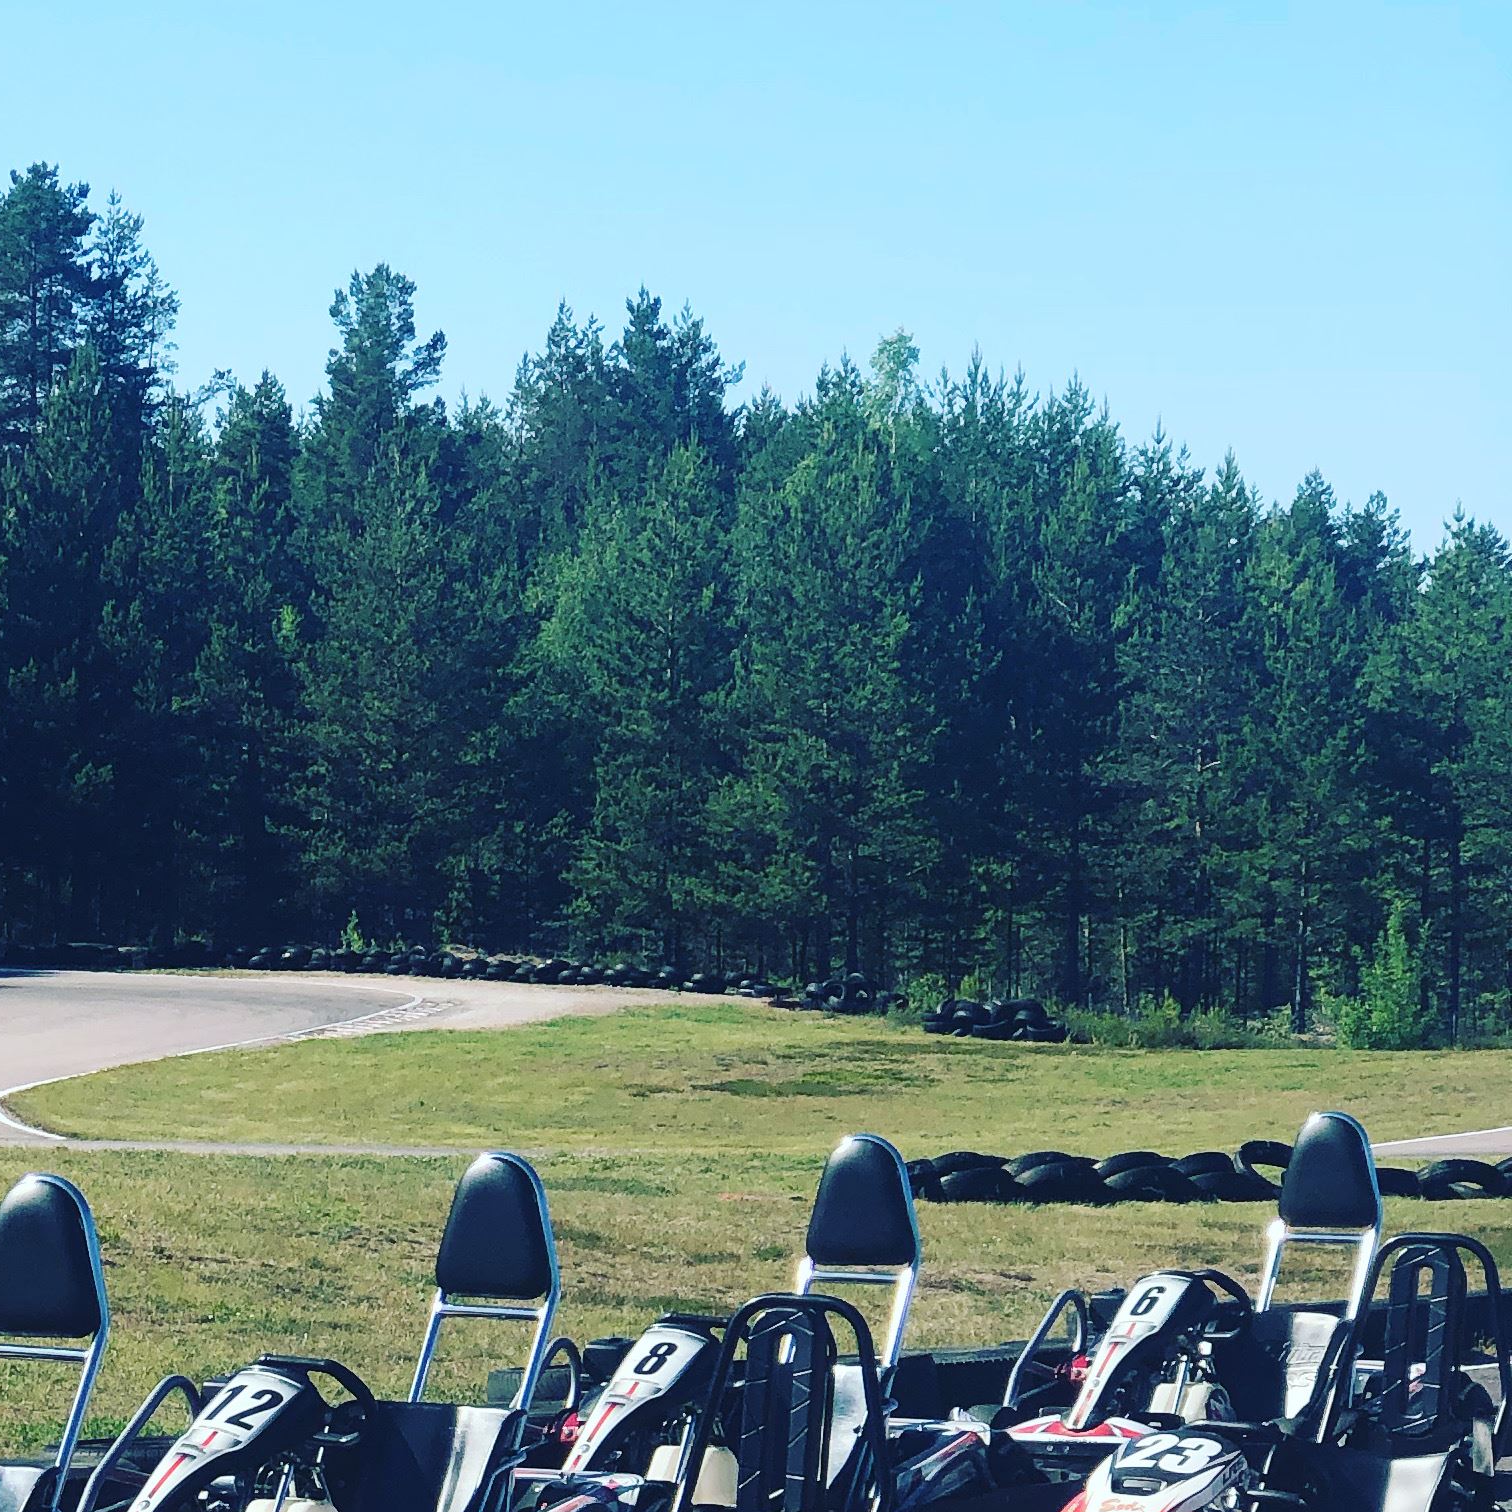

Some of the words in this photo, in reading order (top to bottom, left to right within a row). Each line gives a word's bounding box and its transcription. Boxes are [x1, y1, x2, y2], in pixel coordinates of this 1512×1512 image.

[1130, 1286, 1167, 1316] 6
[633, 1341, 678, 1375] 8
[205, 1384, 284, 1430] 12
[1115, 1434, 1222, 1474] 23
